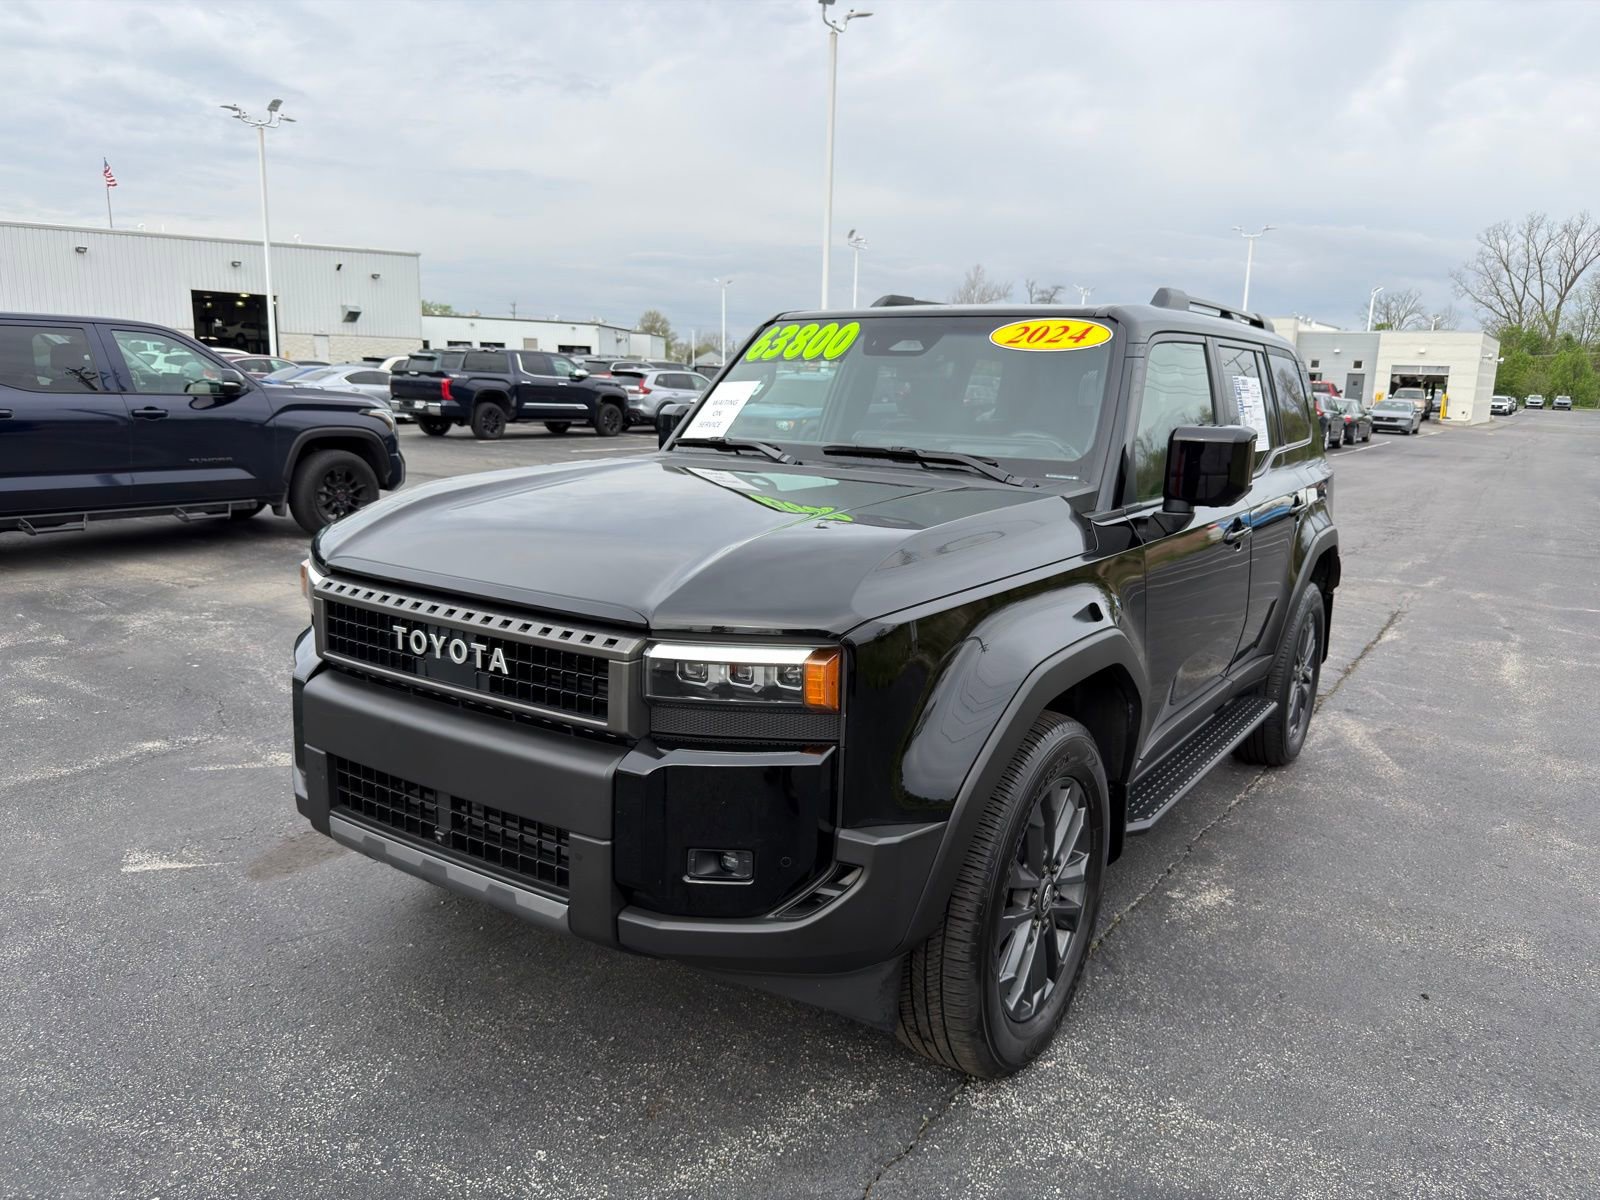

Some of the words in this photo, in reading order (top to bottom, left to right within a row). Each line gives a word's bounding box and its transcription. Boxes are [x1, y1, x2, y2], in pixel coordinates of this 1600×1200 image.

[745, 321, 860, 362] 63800
[1004, 325, 1095, 344] 2024
[392, 625, 509, 675] TOYOTA
